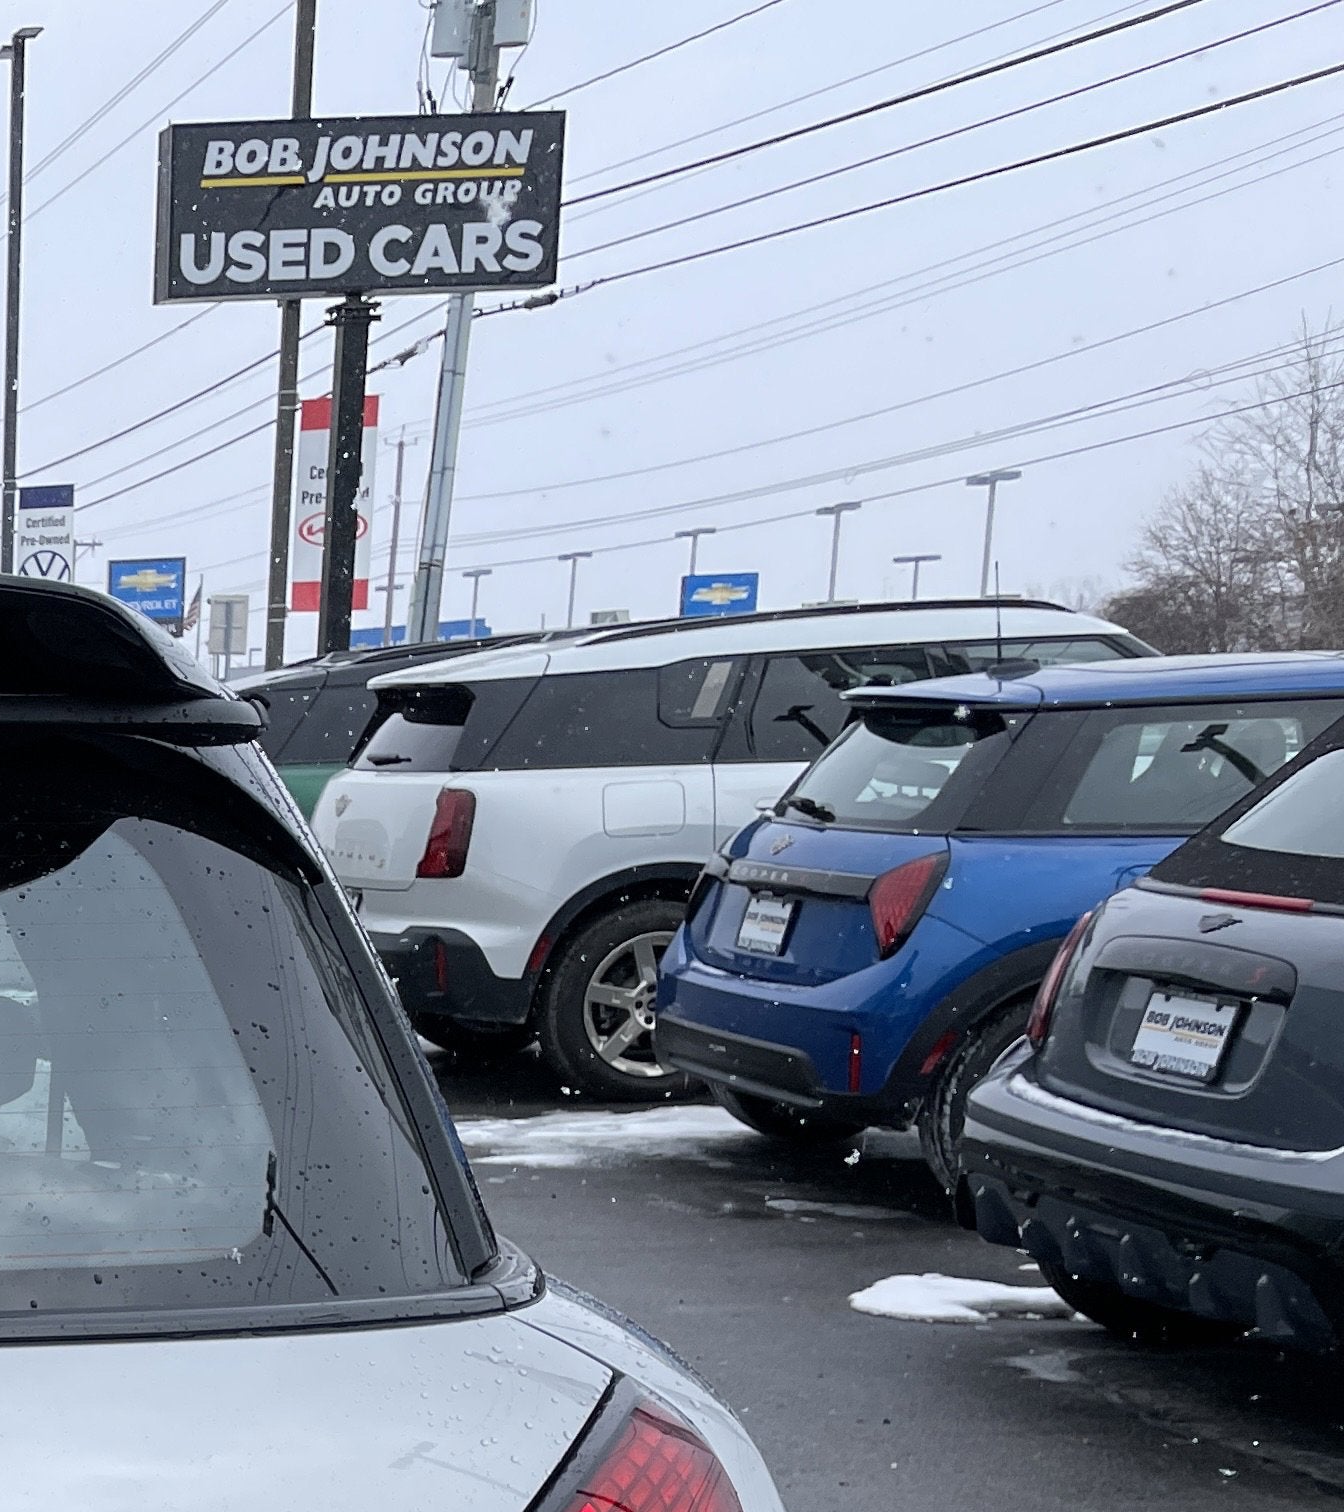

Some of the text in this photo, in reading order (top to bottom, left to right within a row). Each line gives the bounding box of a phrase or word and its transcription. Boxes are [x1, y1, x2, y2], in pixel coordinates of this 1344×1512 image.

[202, 128, 534, 183] BOB JOHNSON
[313, 179, 523, 209] AUTO GROUP
[179, 219, 544, 285] USED CARS
[25, 515, 66, 529] Certified
[20, 533, 70, 547] Pre-Owned
[1146, 1010, 1228, 1037] BOB JOHNSON
